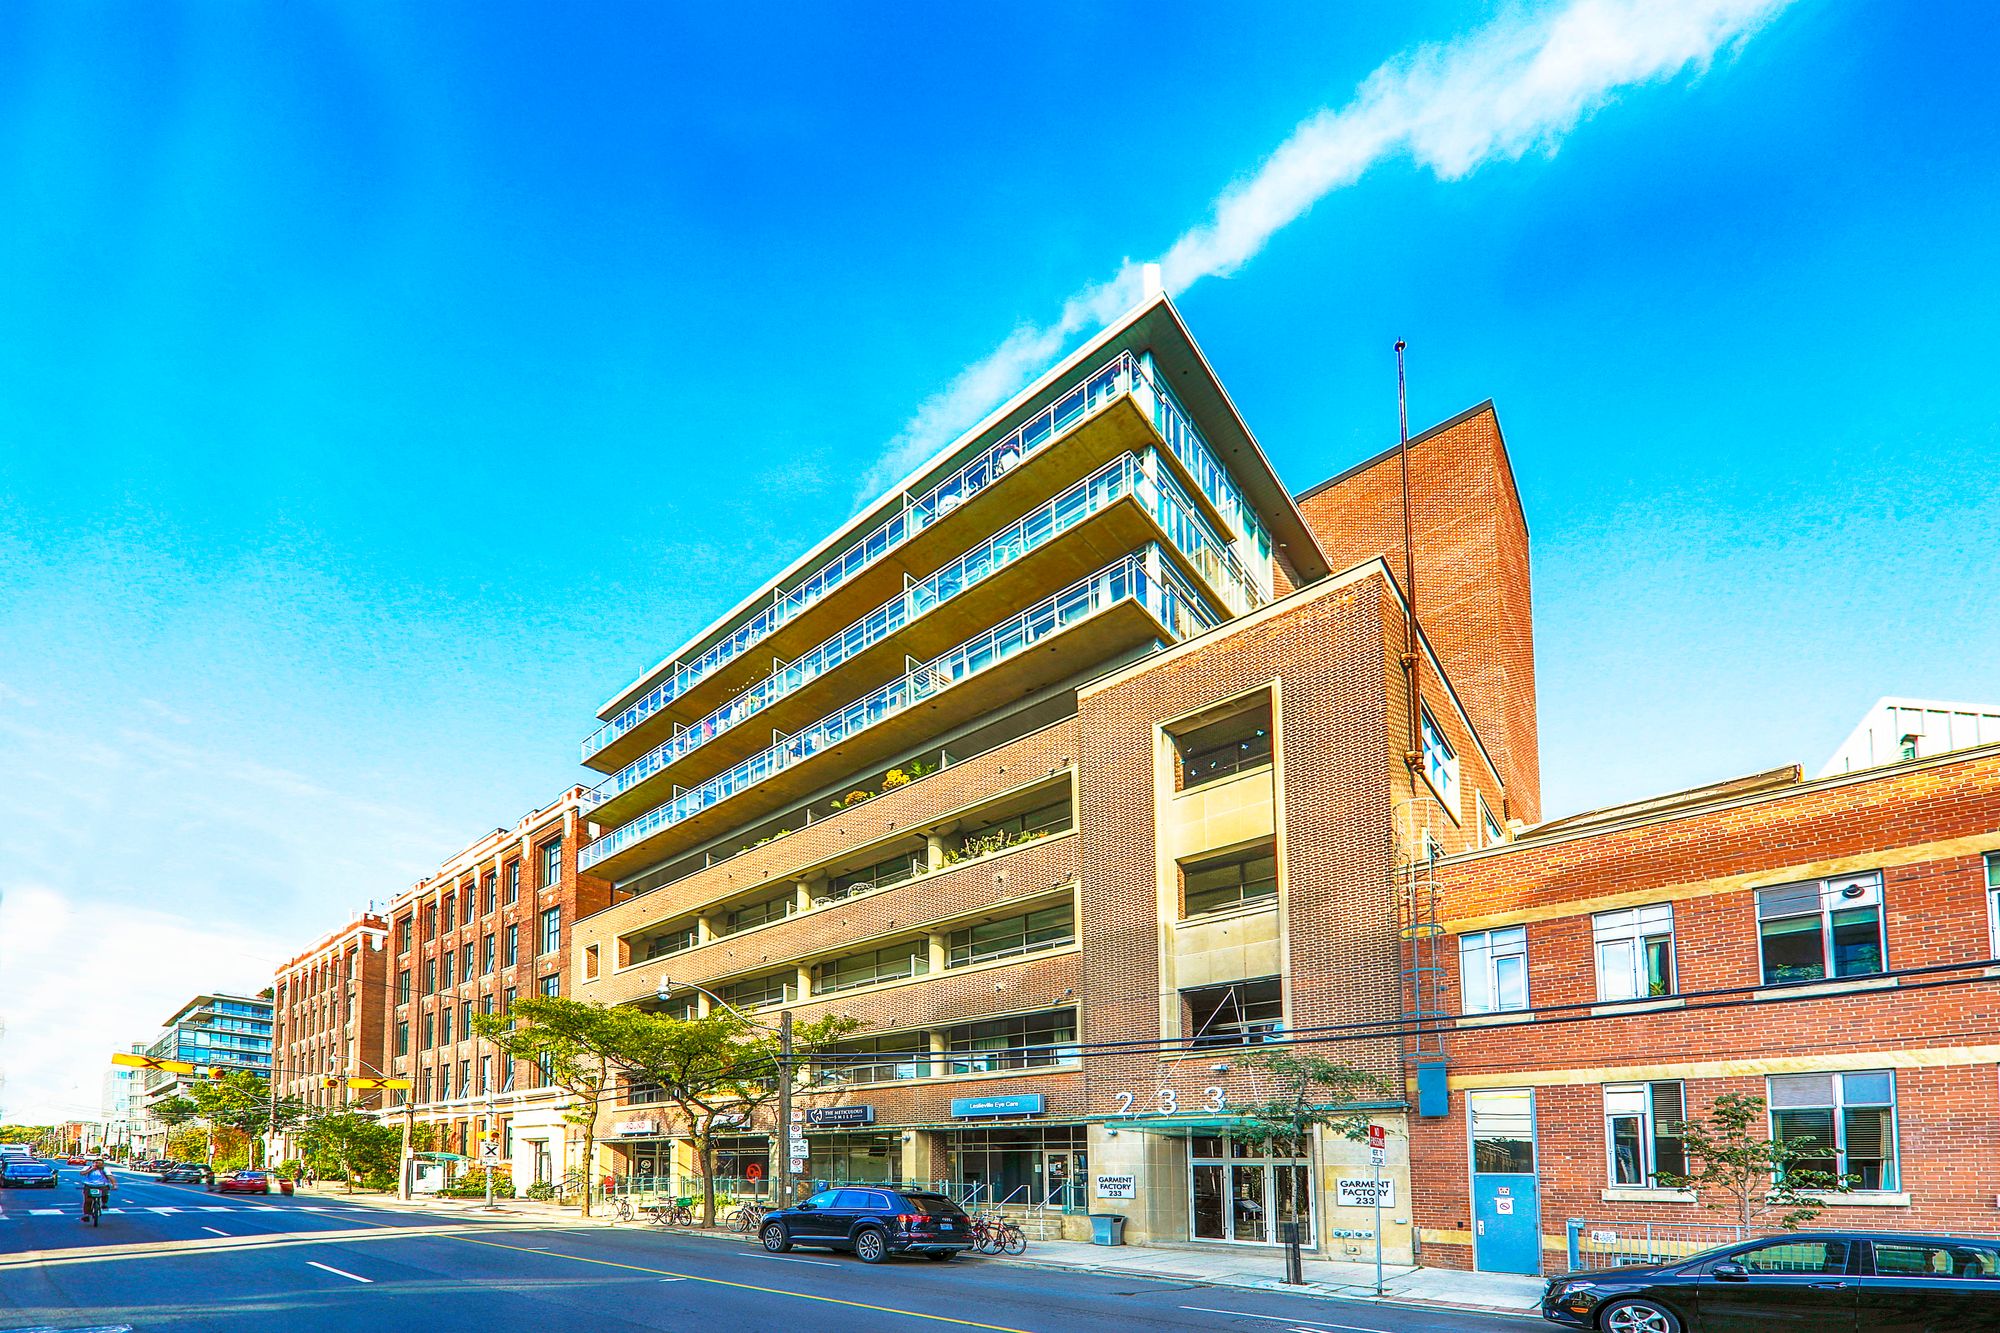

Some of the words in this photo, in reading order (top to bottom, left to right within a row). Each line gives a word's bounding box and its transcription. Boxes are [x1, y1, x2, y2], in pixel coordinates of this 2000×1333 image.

[994, 1101, 1005, 1109] Eye
[1340, 1180, 1391, 1188] GARMENT
[1355, 1197, 1375, 1205] 233
